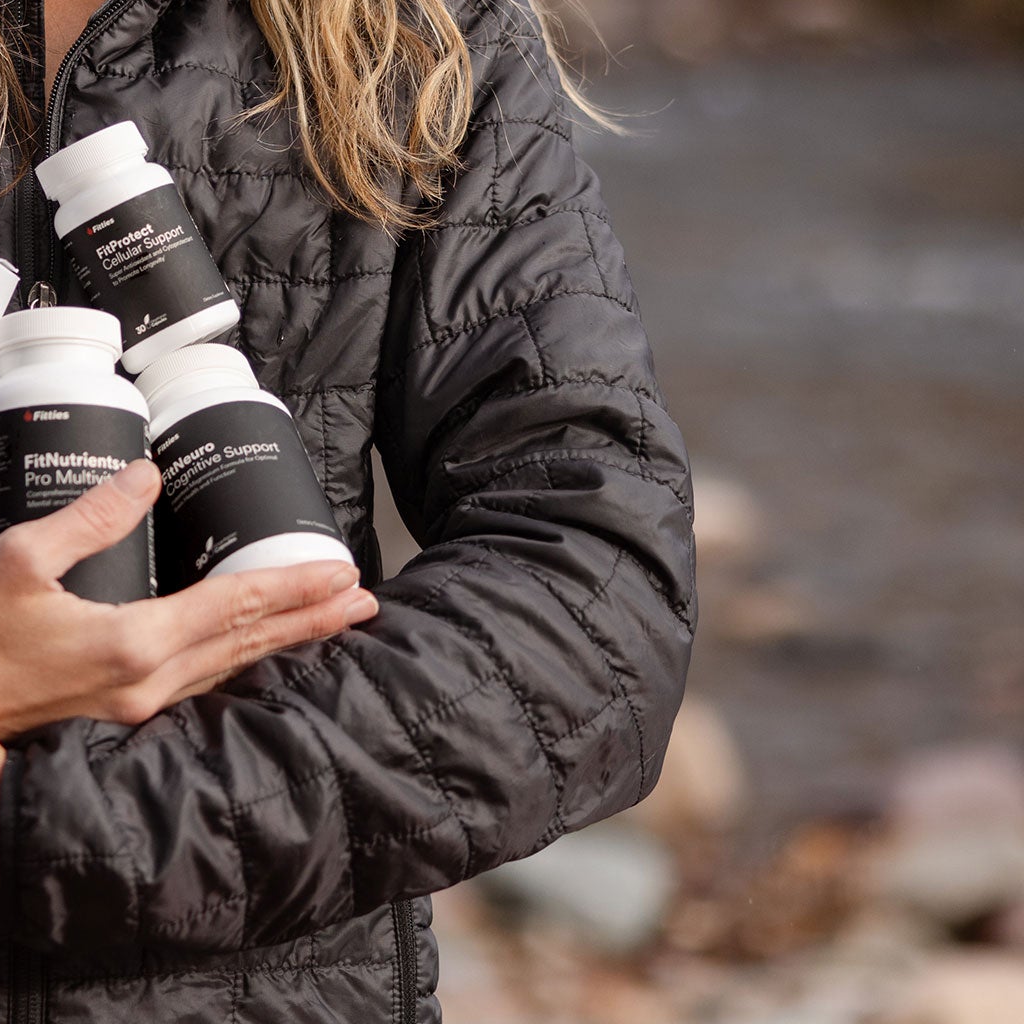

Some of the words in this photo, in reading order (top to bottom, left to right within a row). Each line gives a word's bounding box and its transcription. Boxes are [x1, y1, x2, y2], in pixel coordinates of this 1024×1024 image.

[92, 217, 115, 234] Fitties
[95, 223, 154, 260] FitProtect
[102, 244, 143, 271] Cellular
[143, 225, 185, 250] Support
[33, 410, 70, 421] Fitties
[157, 433, 180, 455] Fitties
[24, 451, 127, 470] FitNutrients+
[161, 442, 215, 485] FitNeuro
[166, 453, 222, 496] Cognitive
[223, 442, 280, 458] Support
[25, 472, 52, 487] Pro
